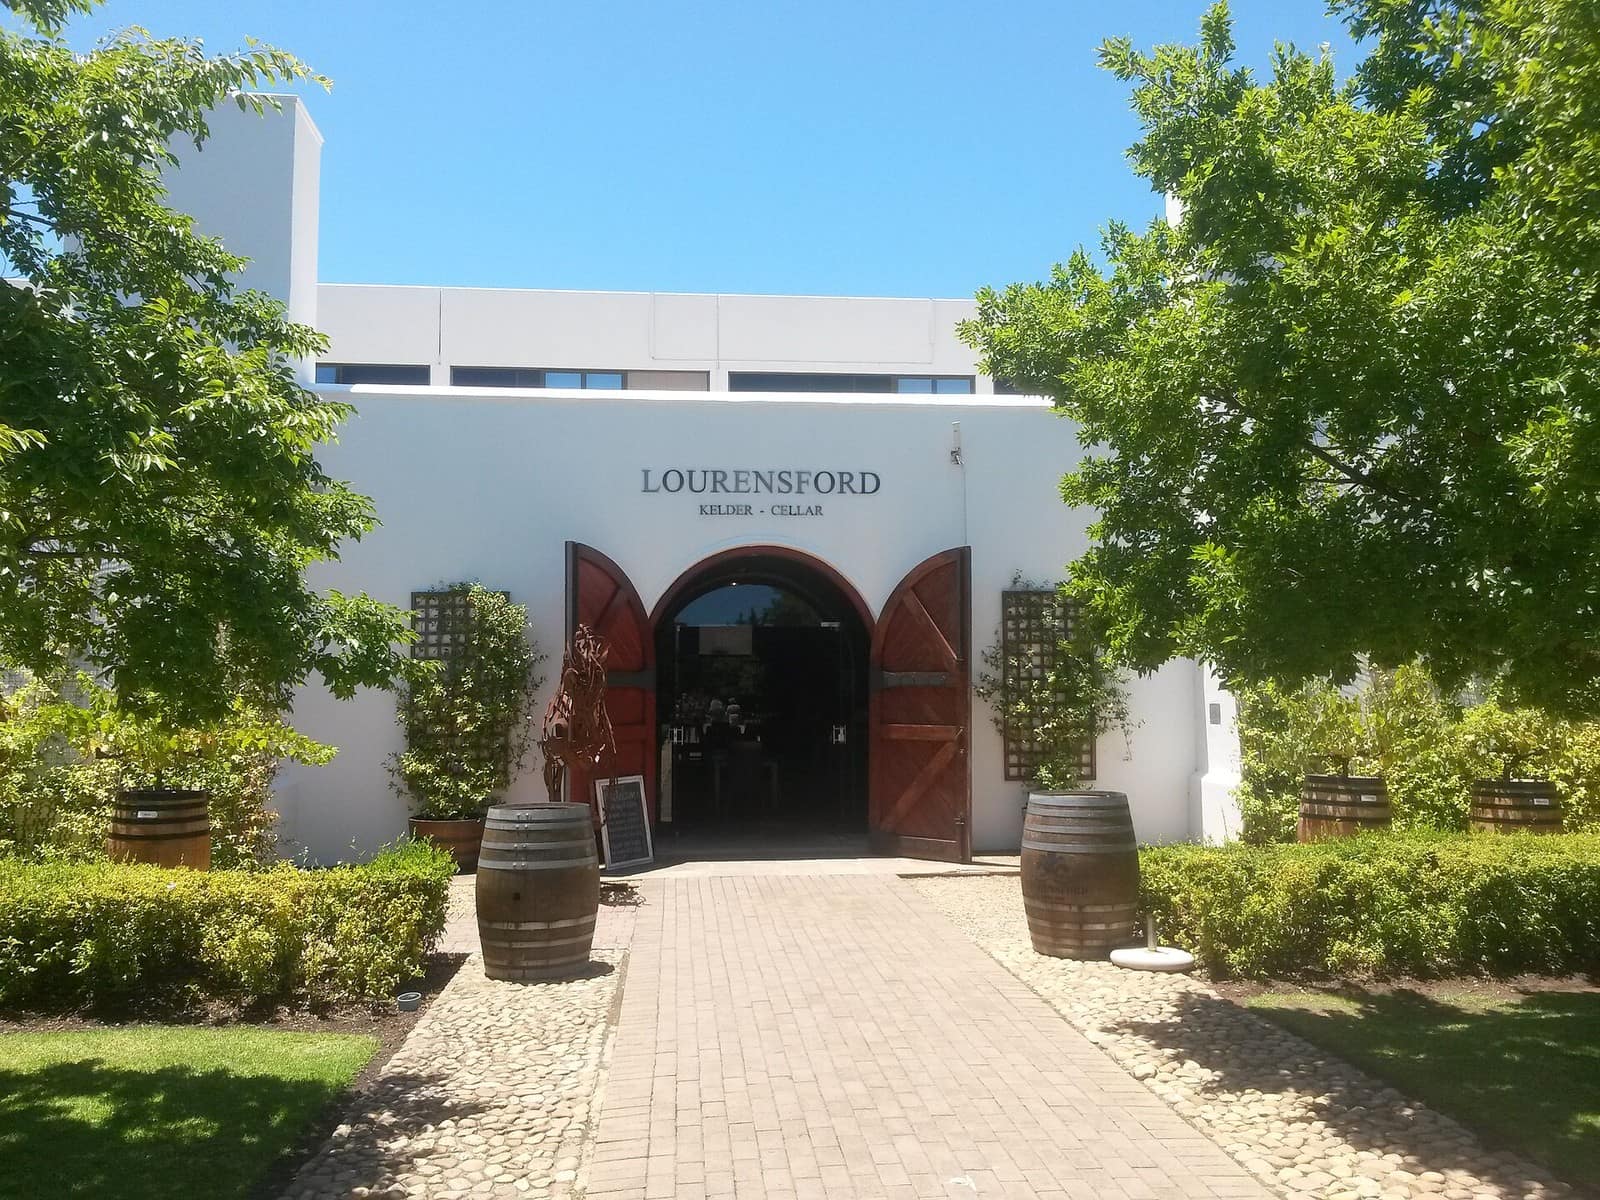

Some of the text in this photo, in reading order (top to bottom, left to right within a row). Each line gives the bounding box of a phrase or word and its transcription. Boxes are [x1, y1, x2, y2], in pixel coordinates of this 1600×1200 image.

[641, 469, 881, 495] LOURENSFORD
[699, 504, 753, 516] KELDER
[771, 504, 824, 517] CELLAR
